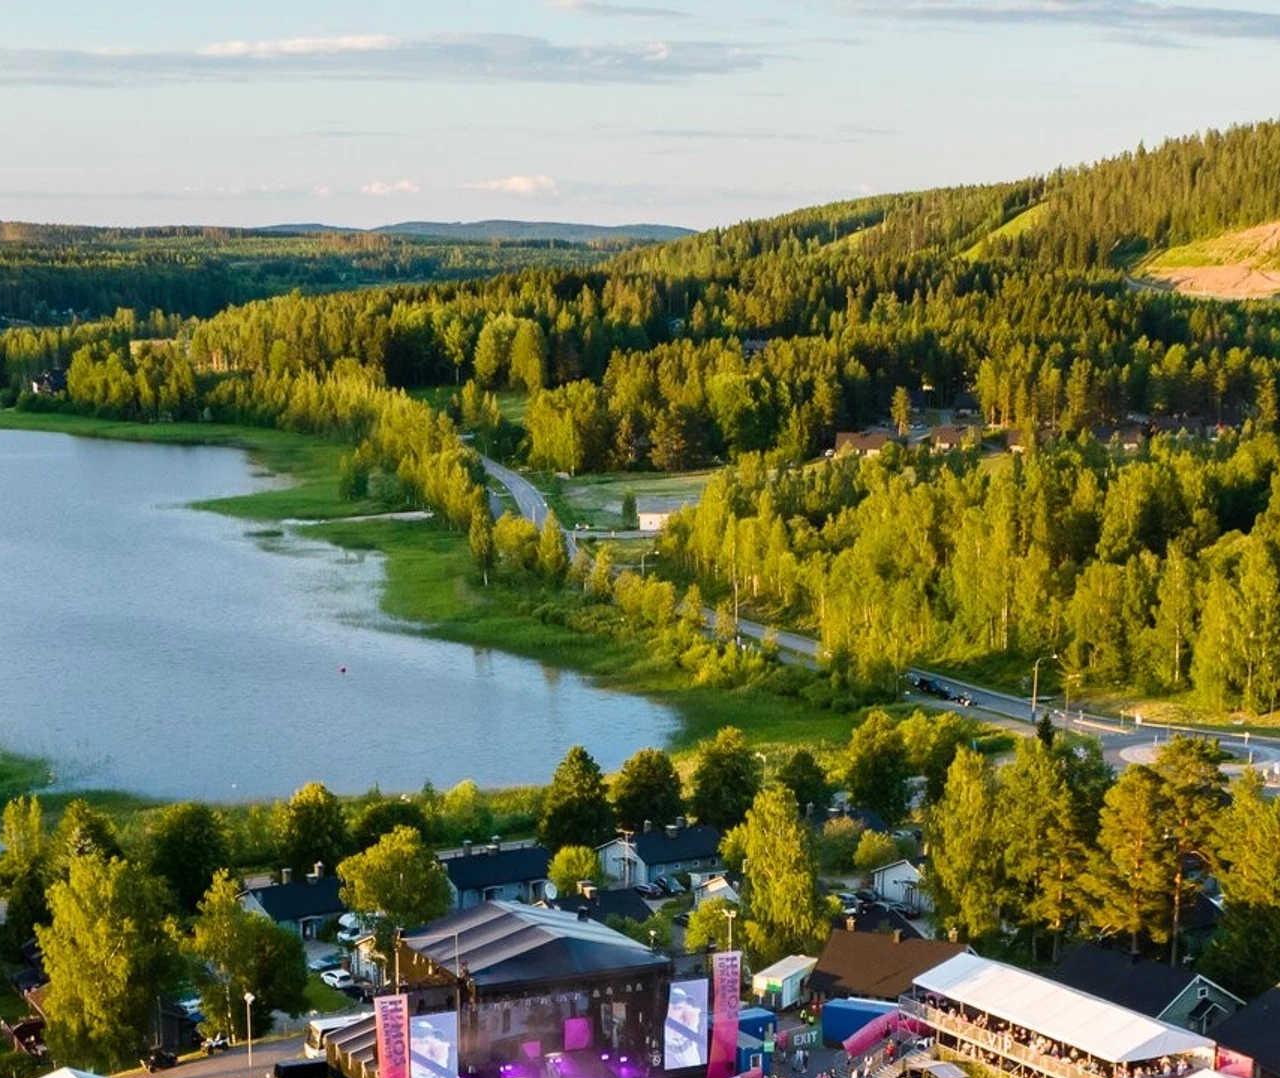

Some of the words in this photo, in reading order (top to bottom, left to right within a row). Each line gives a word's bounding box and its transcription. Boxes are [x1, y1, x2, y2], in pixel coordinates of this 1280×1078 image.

[389, 1000, 406, 1067] HIMOS
[793, 1031, 818, 1046] EXIT
[987, 1032, 1013, 1053] VIP
